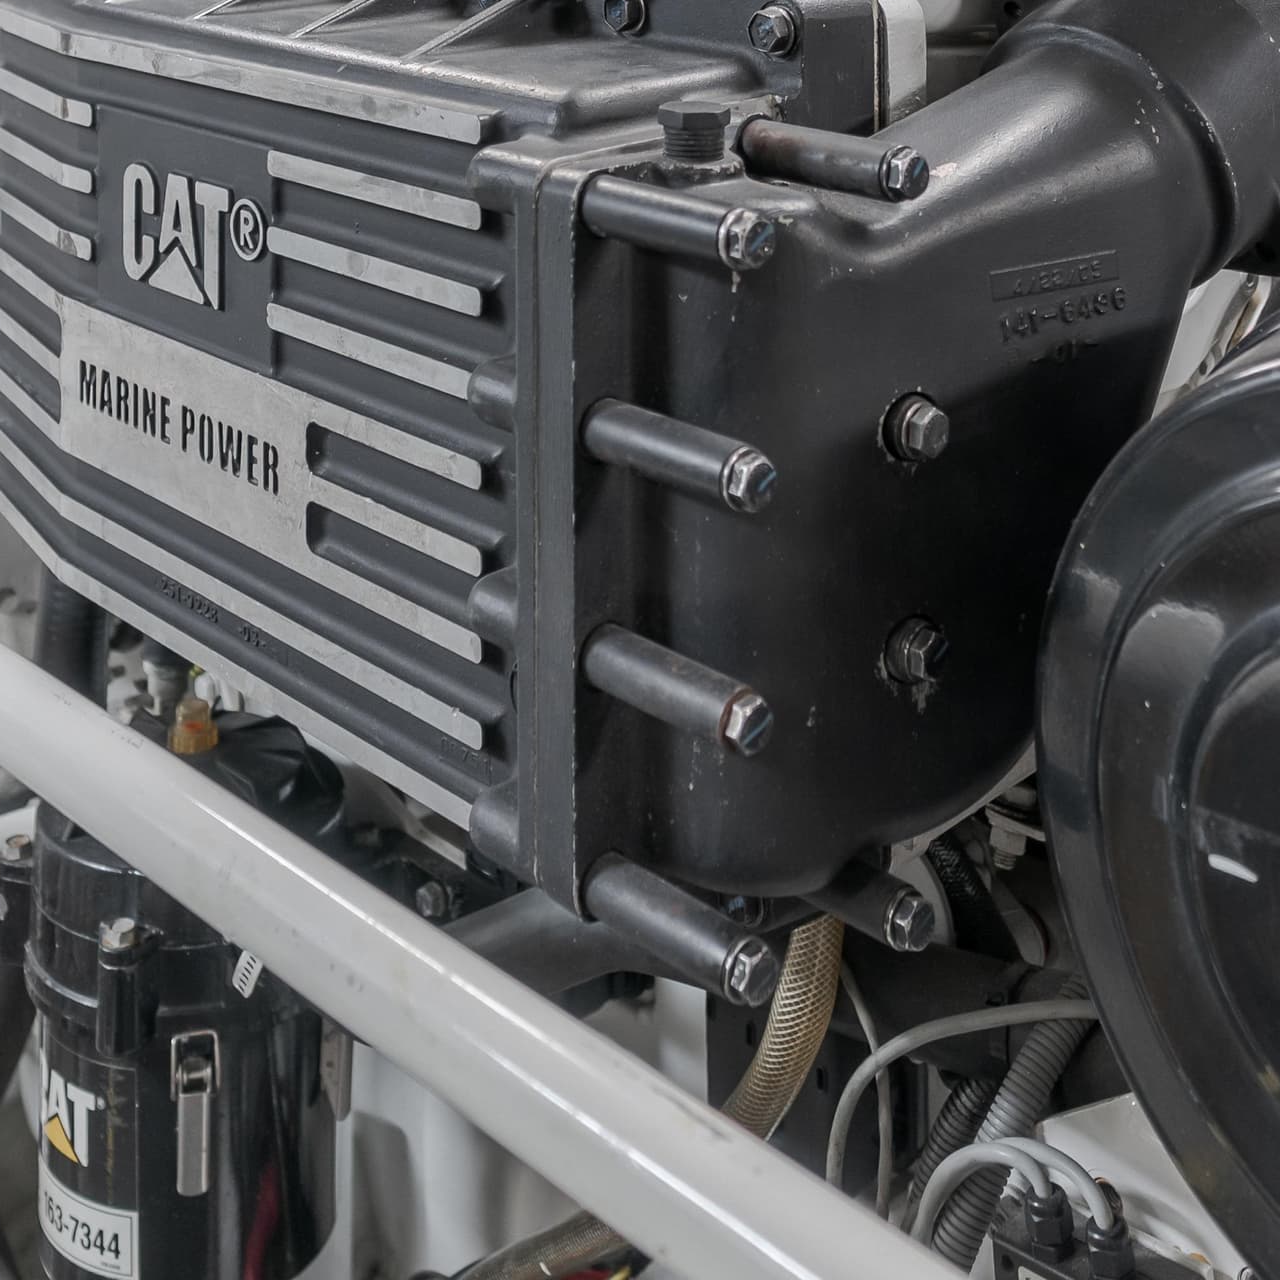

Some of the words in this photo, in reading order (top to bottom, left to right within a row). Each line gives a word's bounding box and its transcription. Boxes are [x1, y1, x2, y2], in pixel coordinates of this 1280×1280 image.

[79, 359, 171, 445] MARINE
[181, 404, 279, 497] POWER
[44, 1191, 121, 1260] 163-7344
